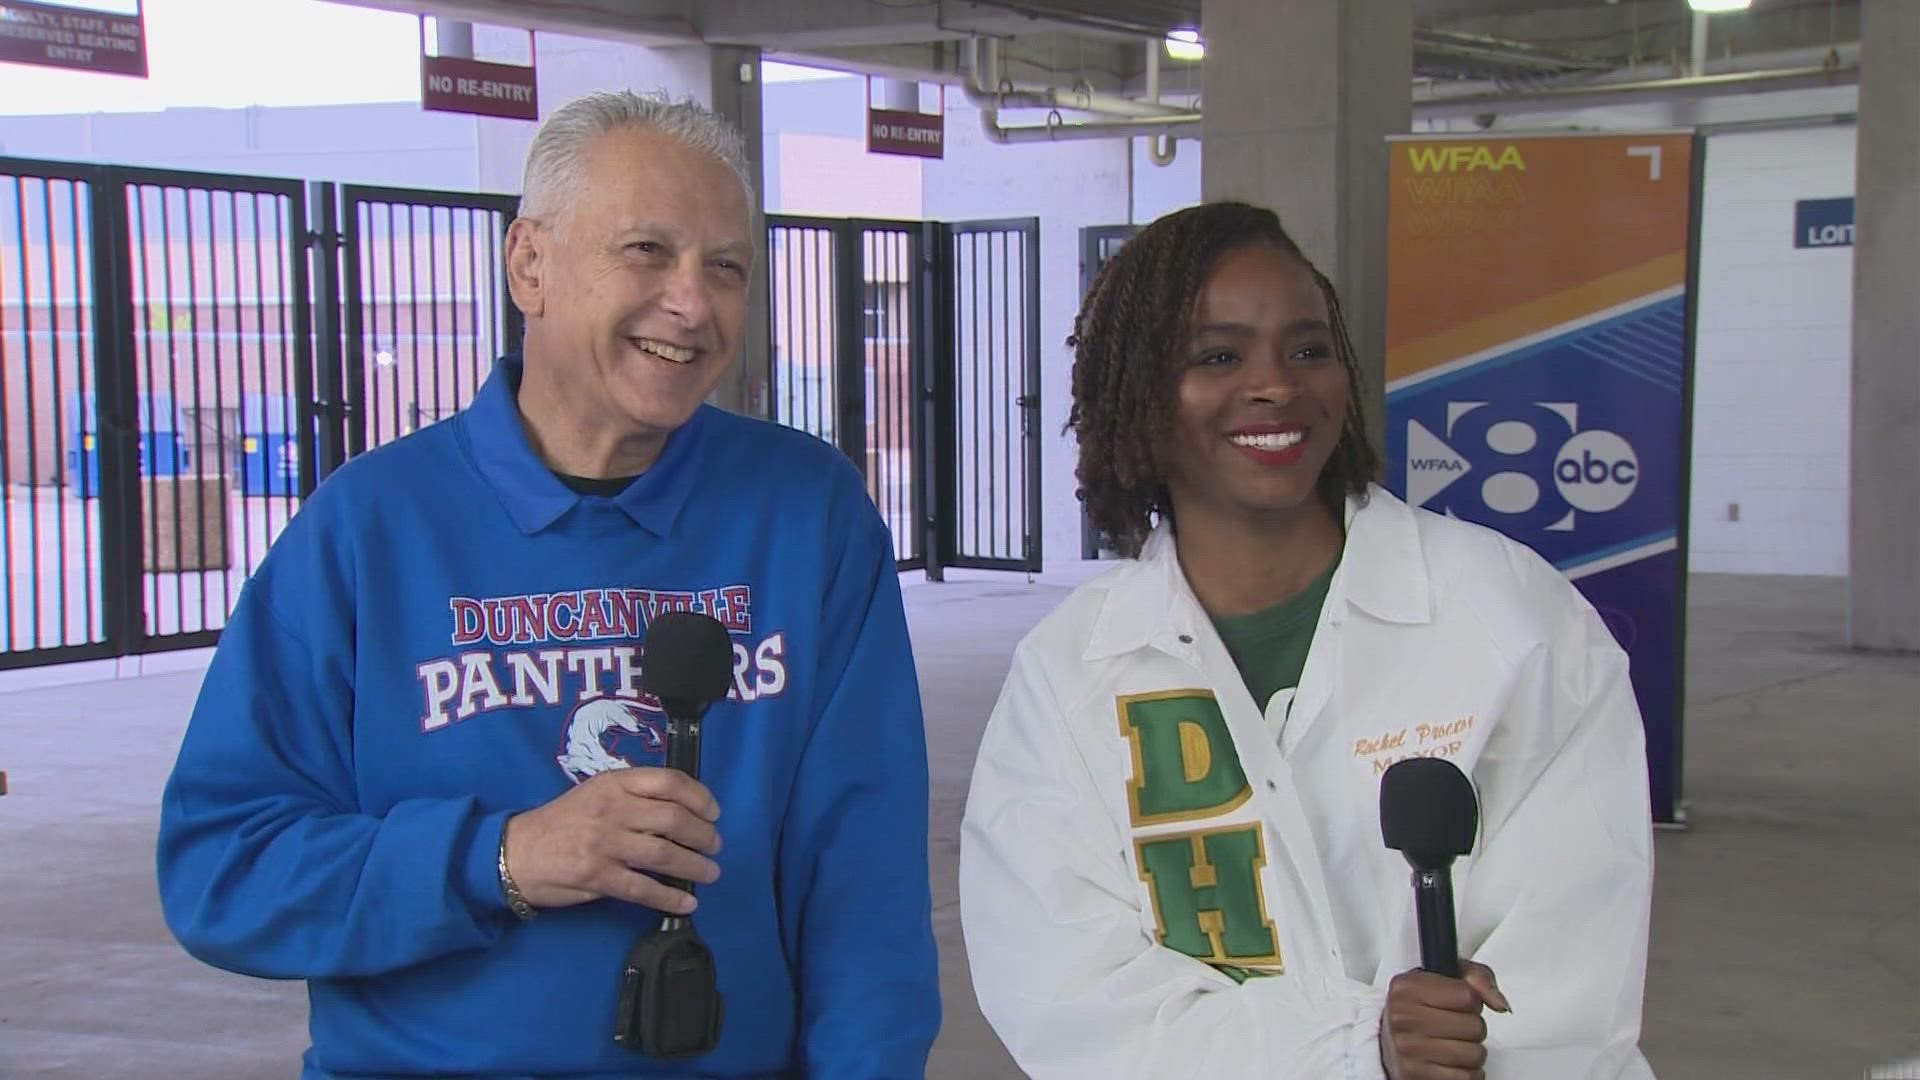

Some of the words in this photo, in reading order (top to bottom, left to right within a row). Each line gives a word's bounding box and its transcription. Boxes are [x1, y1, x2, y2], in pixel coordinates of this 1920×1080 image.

[0, 6, 59, 27] ACULTY,
[111, 22, 139, 36] AND
[46, 45, 94, 62] ENTRY
[78, 32, 136, 52] SEATING
[429, 74, 453, 93] NO
[457, 78, 532, 103] RE-ENTRY
[872, 124, 888, 139] NO
[891, 126, 941, 144] RE-ENTRY
[1408, 145, 1526, 172] WFAA
[1410, 459, 1463, 472] WFAA
[1556, 450, 1636, 484] abc
[417, 632, 787, 731] PANTHRS
[1354, 729, 1407, 757] Rachel
[1115, 688, 1253, 828] D
[1372, 741, 1461, 776] MYOR
[1133, 820, 1284, 968] H
